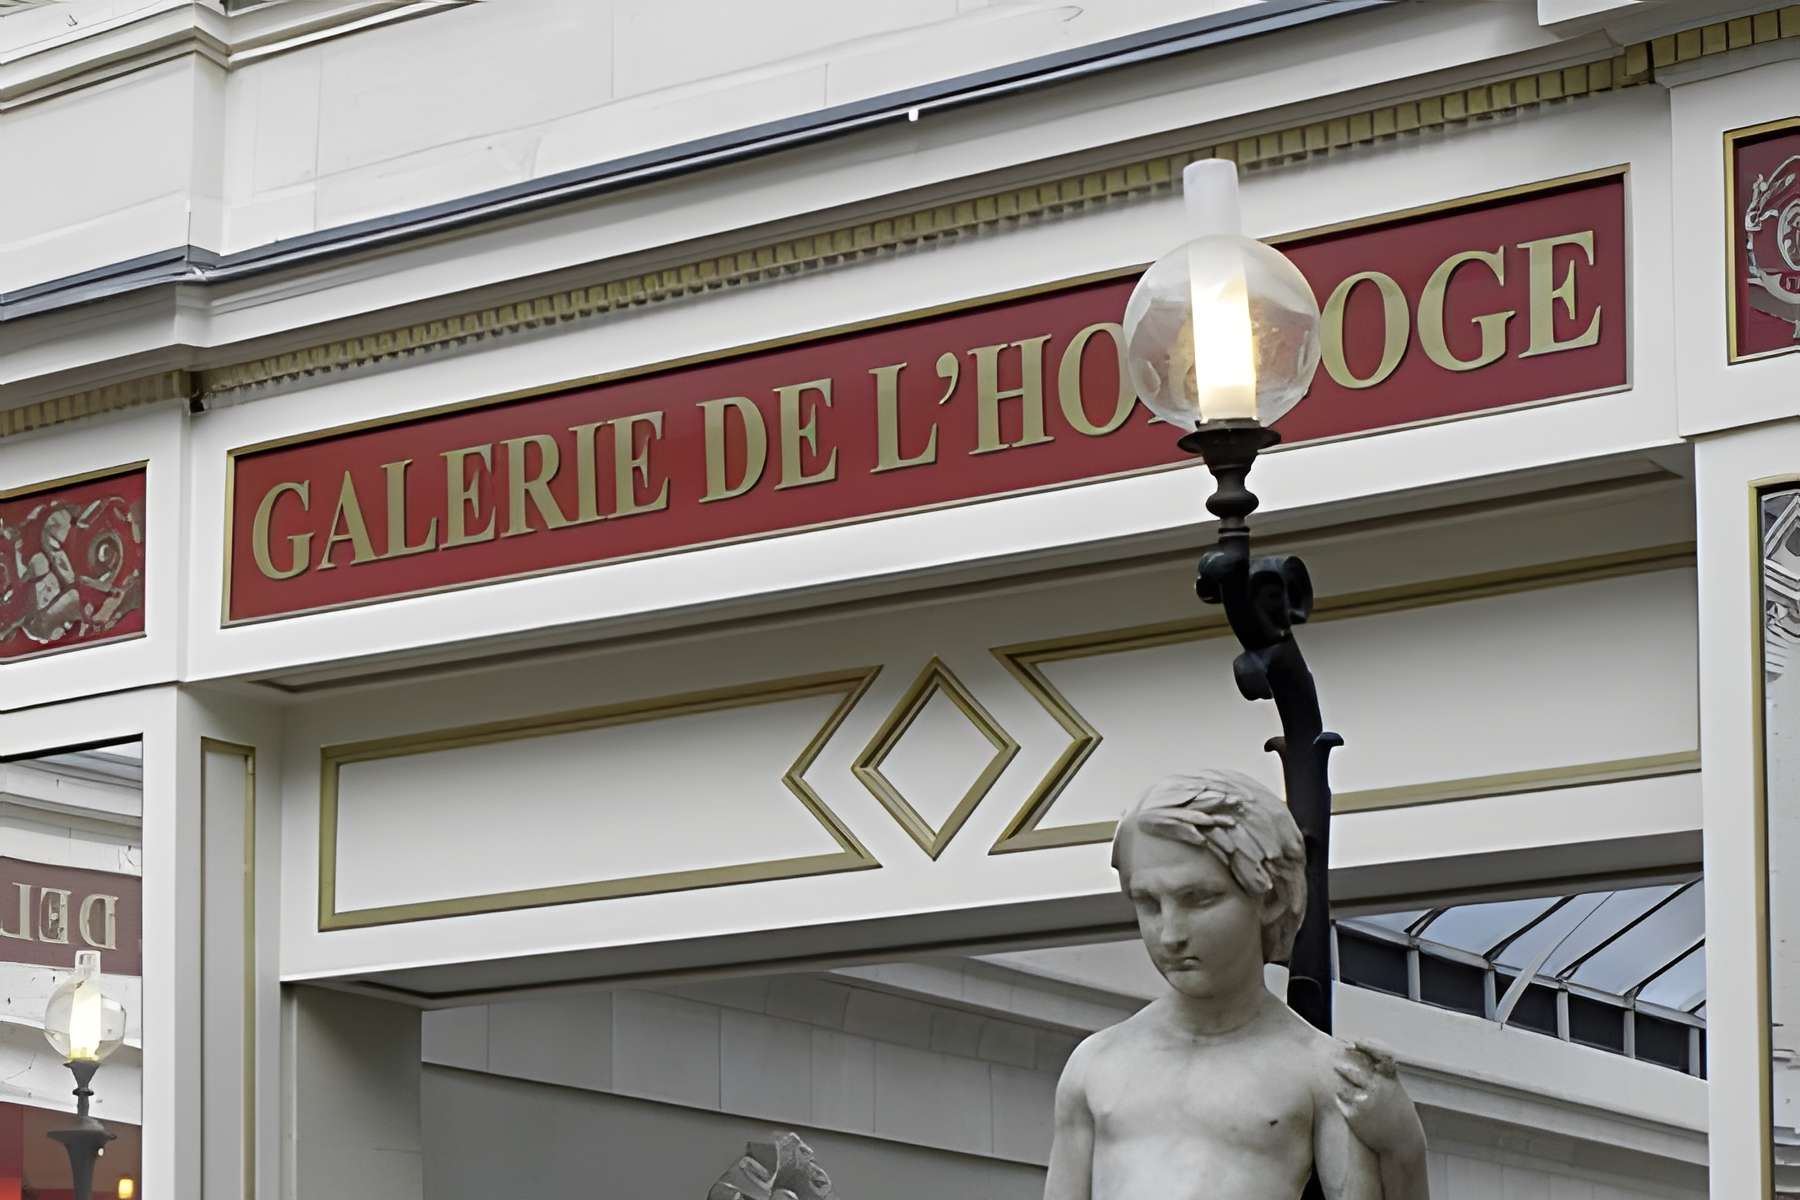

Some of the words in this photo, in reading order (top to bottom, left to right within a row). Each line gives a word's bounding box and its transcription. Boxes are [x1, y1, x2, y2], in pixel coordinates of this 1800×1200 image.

[251, 411, 670, 580] GALERIE
[697, 377, 838, 505] DE
[869, 229, 1601, 474] L'HOOGE
